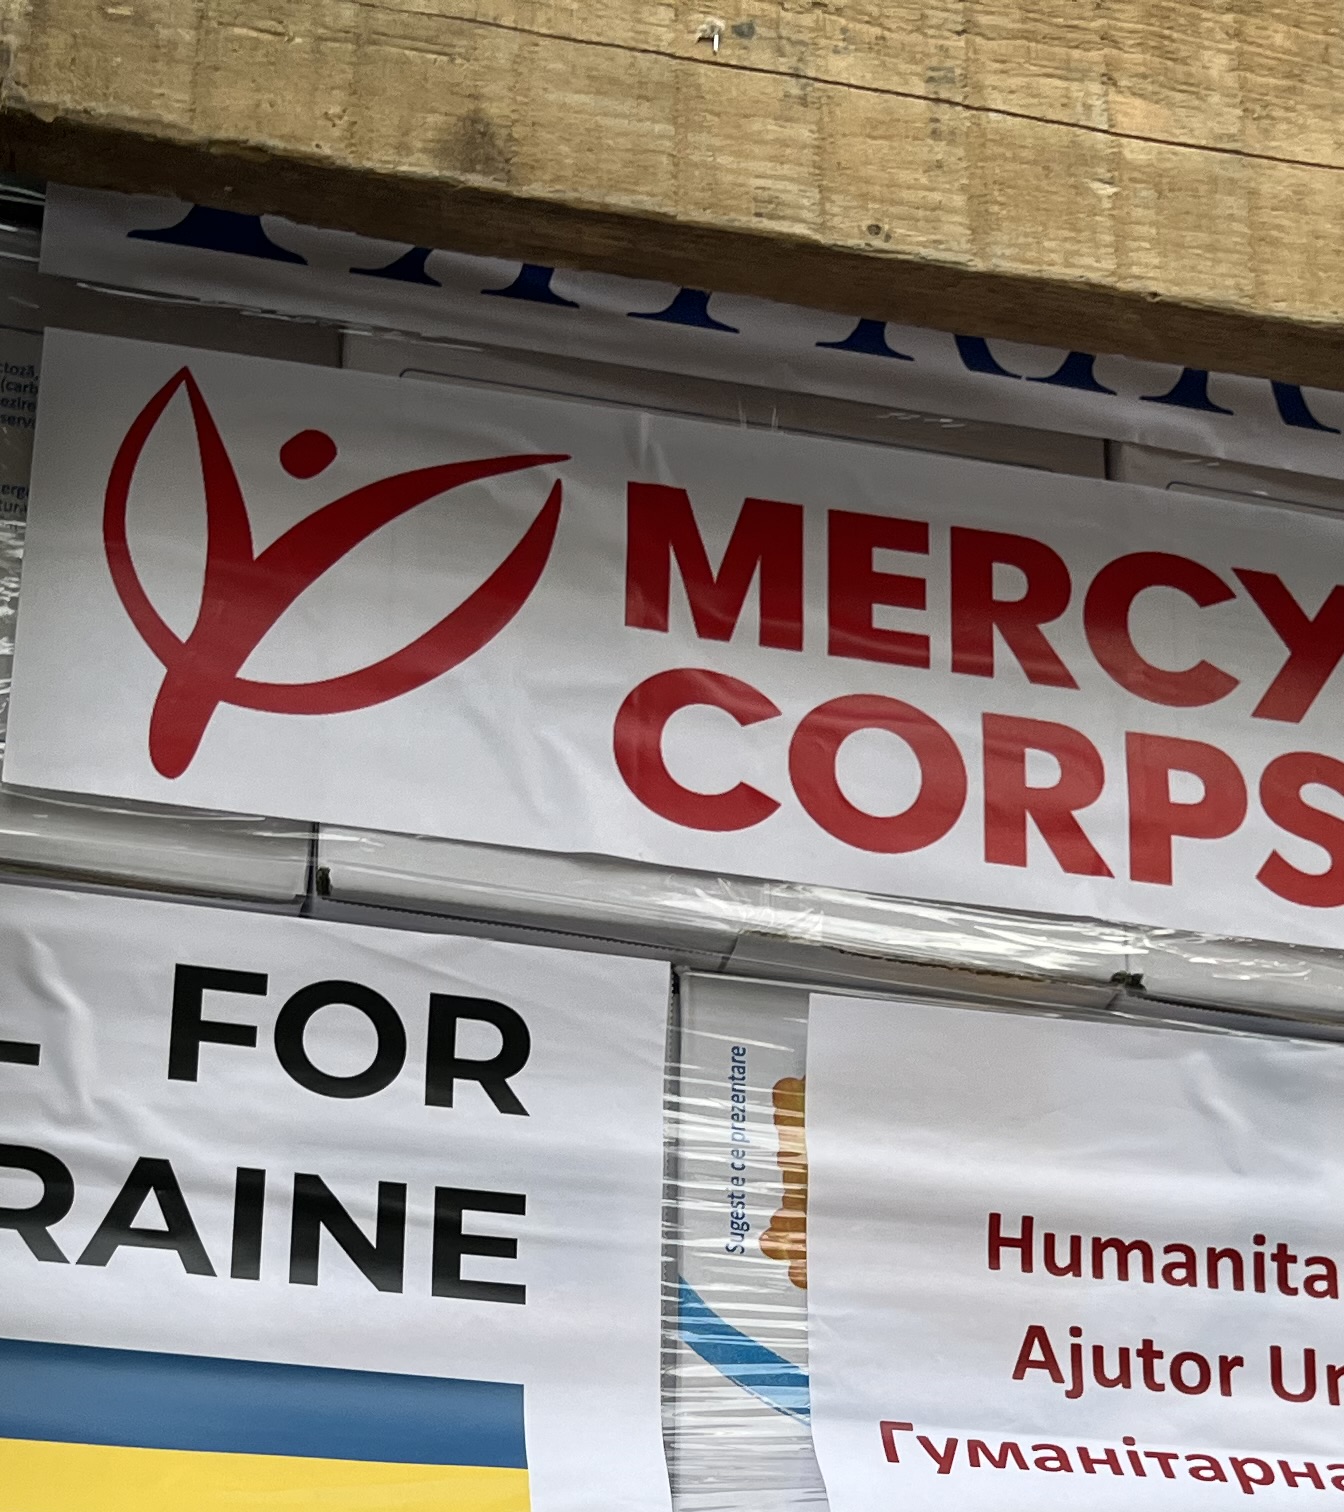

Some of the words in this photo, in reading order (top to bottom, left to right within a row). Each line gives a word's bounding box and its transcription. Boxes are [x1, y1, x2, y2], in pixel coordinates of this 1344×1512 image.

[167, 963, 531, 1117] FOR
[728, 1045, 751, 1144] prezentare
[1012, 1325, 1244, 1400] Ajutor
